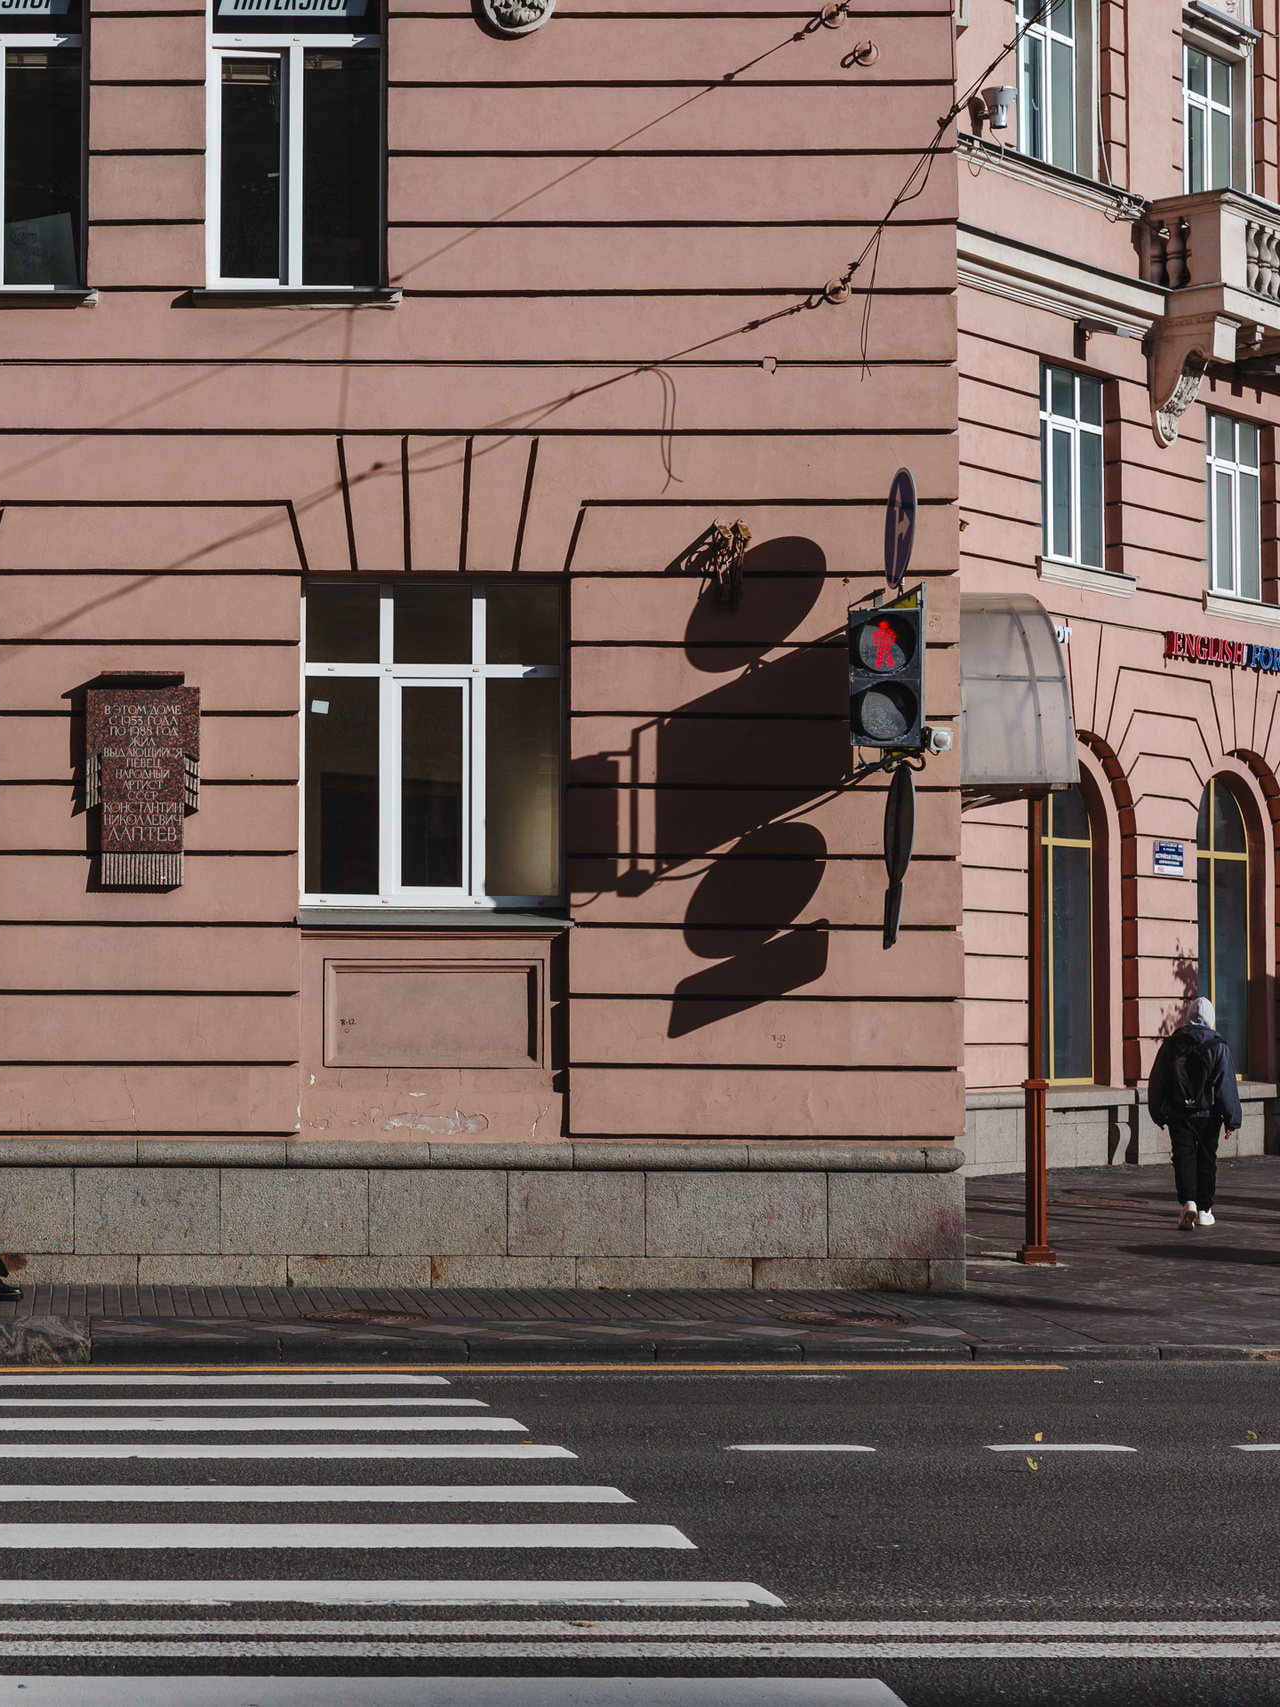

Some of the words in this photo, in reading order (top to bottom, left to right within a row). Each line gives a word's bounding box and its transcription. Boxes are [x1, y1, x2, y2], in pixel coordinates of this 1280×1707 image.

[1172, 631, 1246, 666] ENGLISH
[104, 705, 111, 715] В
[113, 705, 147, 715] ЭТОМ
[150, 705, 182, 715] ДОМЕ
[109, 716, 118, 726] С
[147, 716, 178, 726] ГОДА
[109, 726, 126, 736] ПО
[156, 726, 178, 736] ГОД
[129, 737, 156, 747] ЖИЛ
[103, 747, 183, 758] ВЫДАЮЩИЙСЯ
[126, 758, 161, 768] ПЕВЕЦ
[115, 769, 171, 779] НАРОДНЫЙ
[122, 780, 164, 790] АРТИСТ
[127, 791, 159, 801] СССР
[103, 801, 182, 813] КОНСТАНТИН
[103, 814, 182, 826] НИКОЛАЕВИЧ
[107, 827, 177, 842] ЛАПТЕВ
